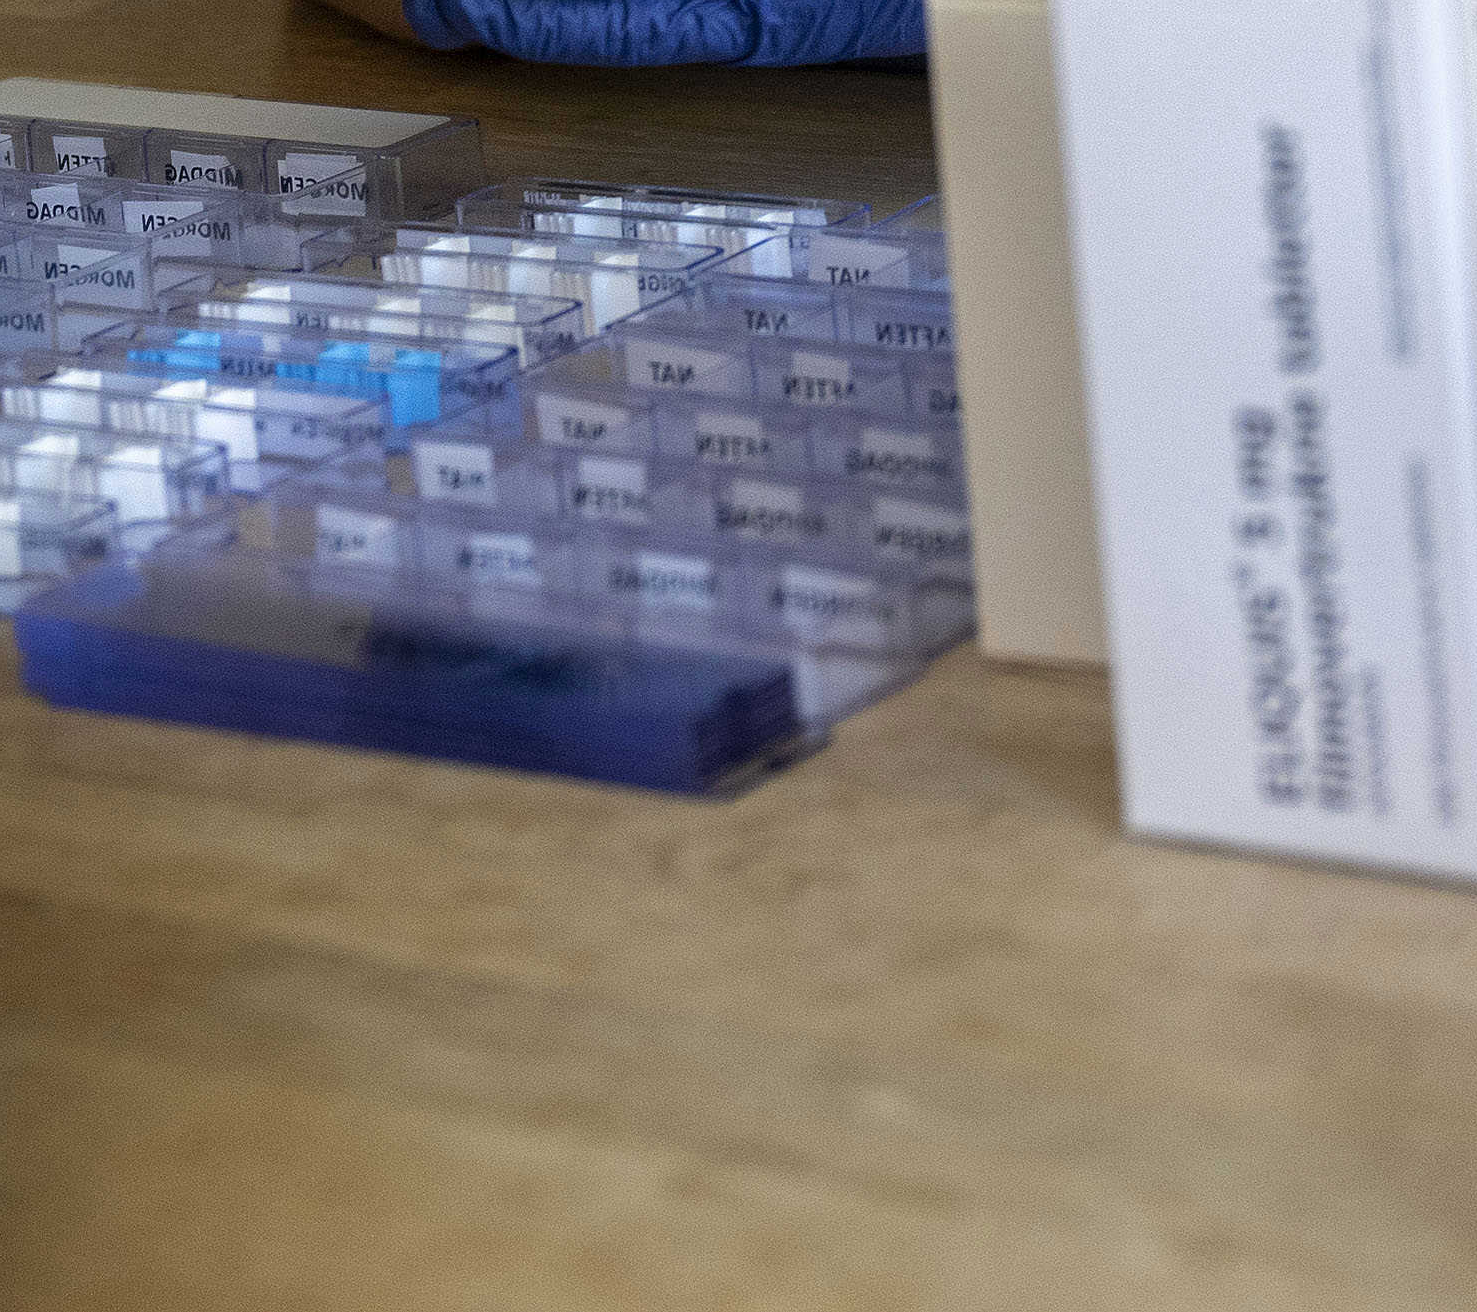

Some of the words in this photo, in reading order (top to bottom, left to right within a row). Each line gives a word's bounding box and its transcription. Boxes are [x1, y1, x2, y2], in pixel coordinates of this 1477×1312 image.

[1257, 120, 1320, 373] tabletter
[1230, 405, 1280, 499] mg
[1231, 513, 1276, 547] 5
